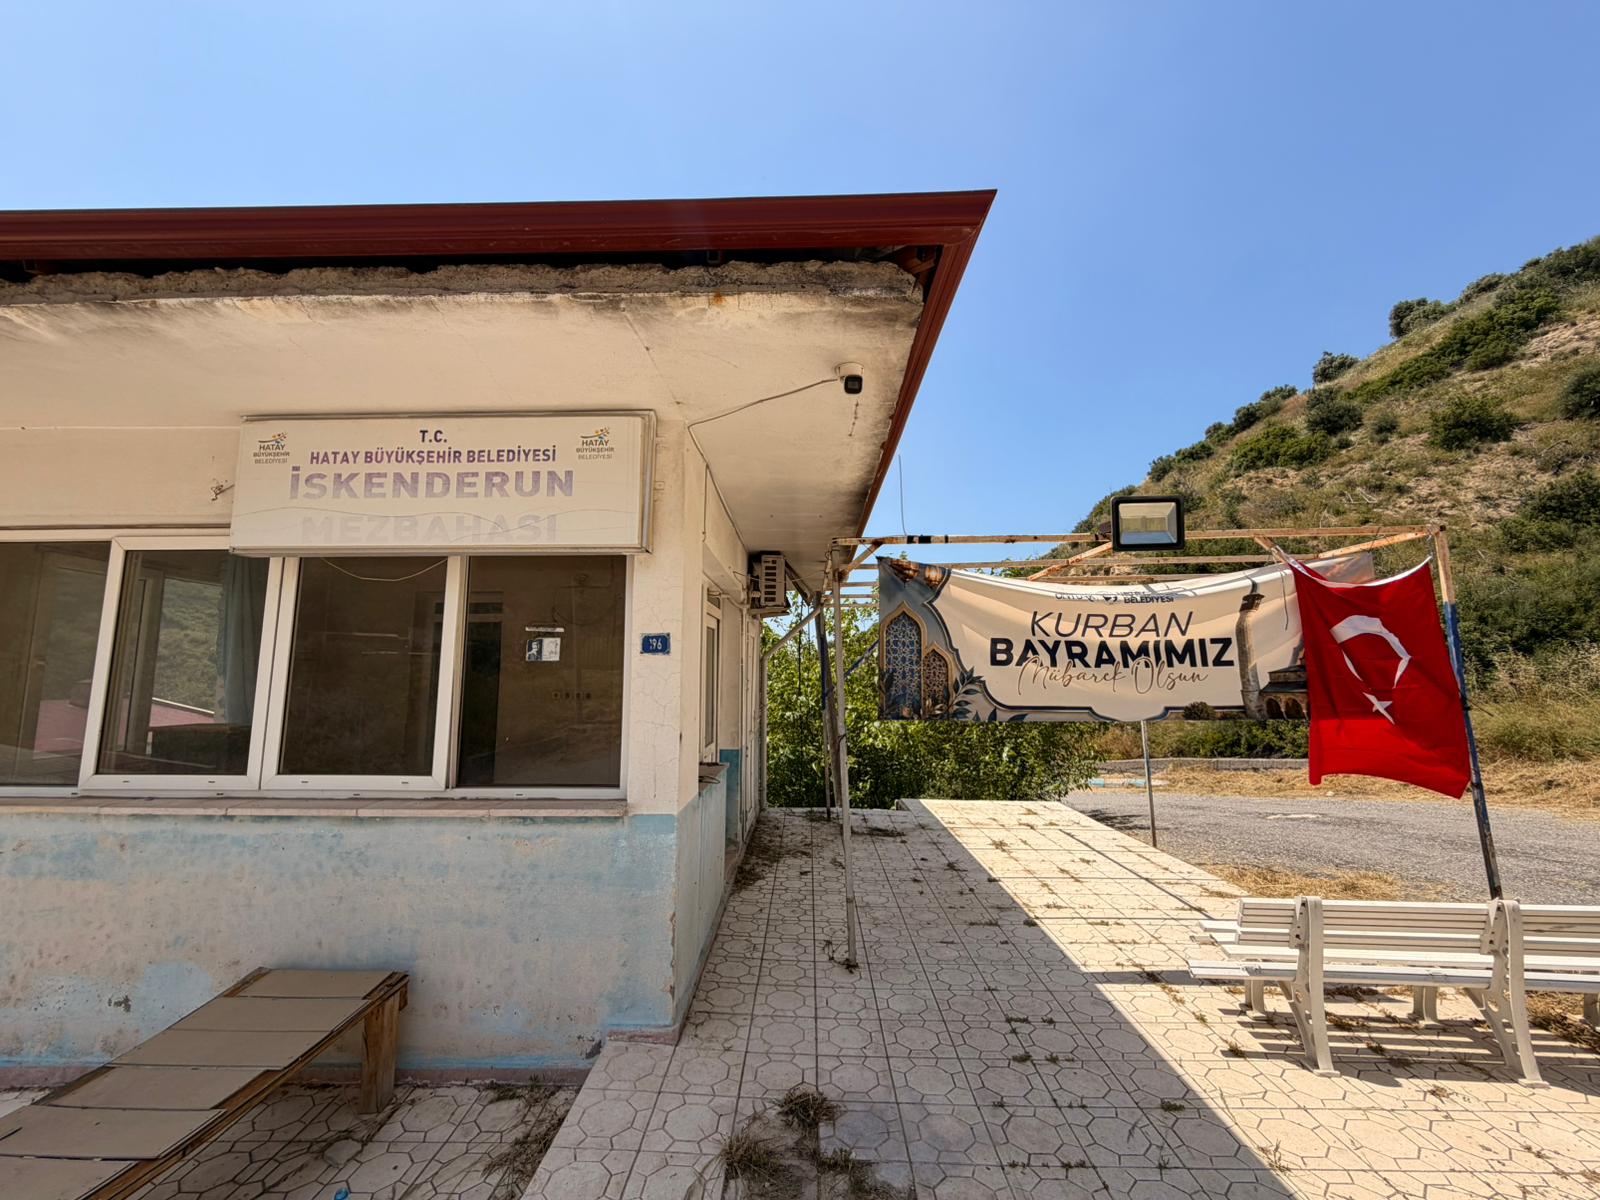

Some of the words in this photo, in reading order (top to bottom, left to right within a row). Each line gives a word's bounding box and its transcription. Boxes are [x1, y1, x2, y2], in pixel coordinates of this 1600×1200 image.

[419, 429, 448, 443] T.C.
[582, 439, 610, 447] HATAY
[309, 451, 361, 465] HATAY
[364, 446, 462, 465] BÜYÜKŞEHİR
[467, 444, 557, 463] BELEDİYESİ
[289, 465, 574, 500] İSKENDERUN
[301, 513, 557, 543] MEZBAHASI
[1031, 610, 1194, 638] KURBAN
[989, 637, 1235, 669] BAYRAMIMIZ
[1017, 655, 1127, 696] Mübarek
[1130, 657, 1209, 695] Olsun
